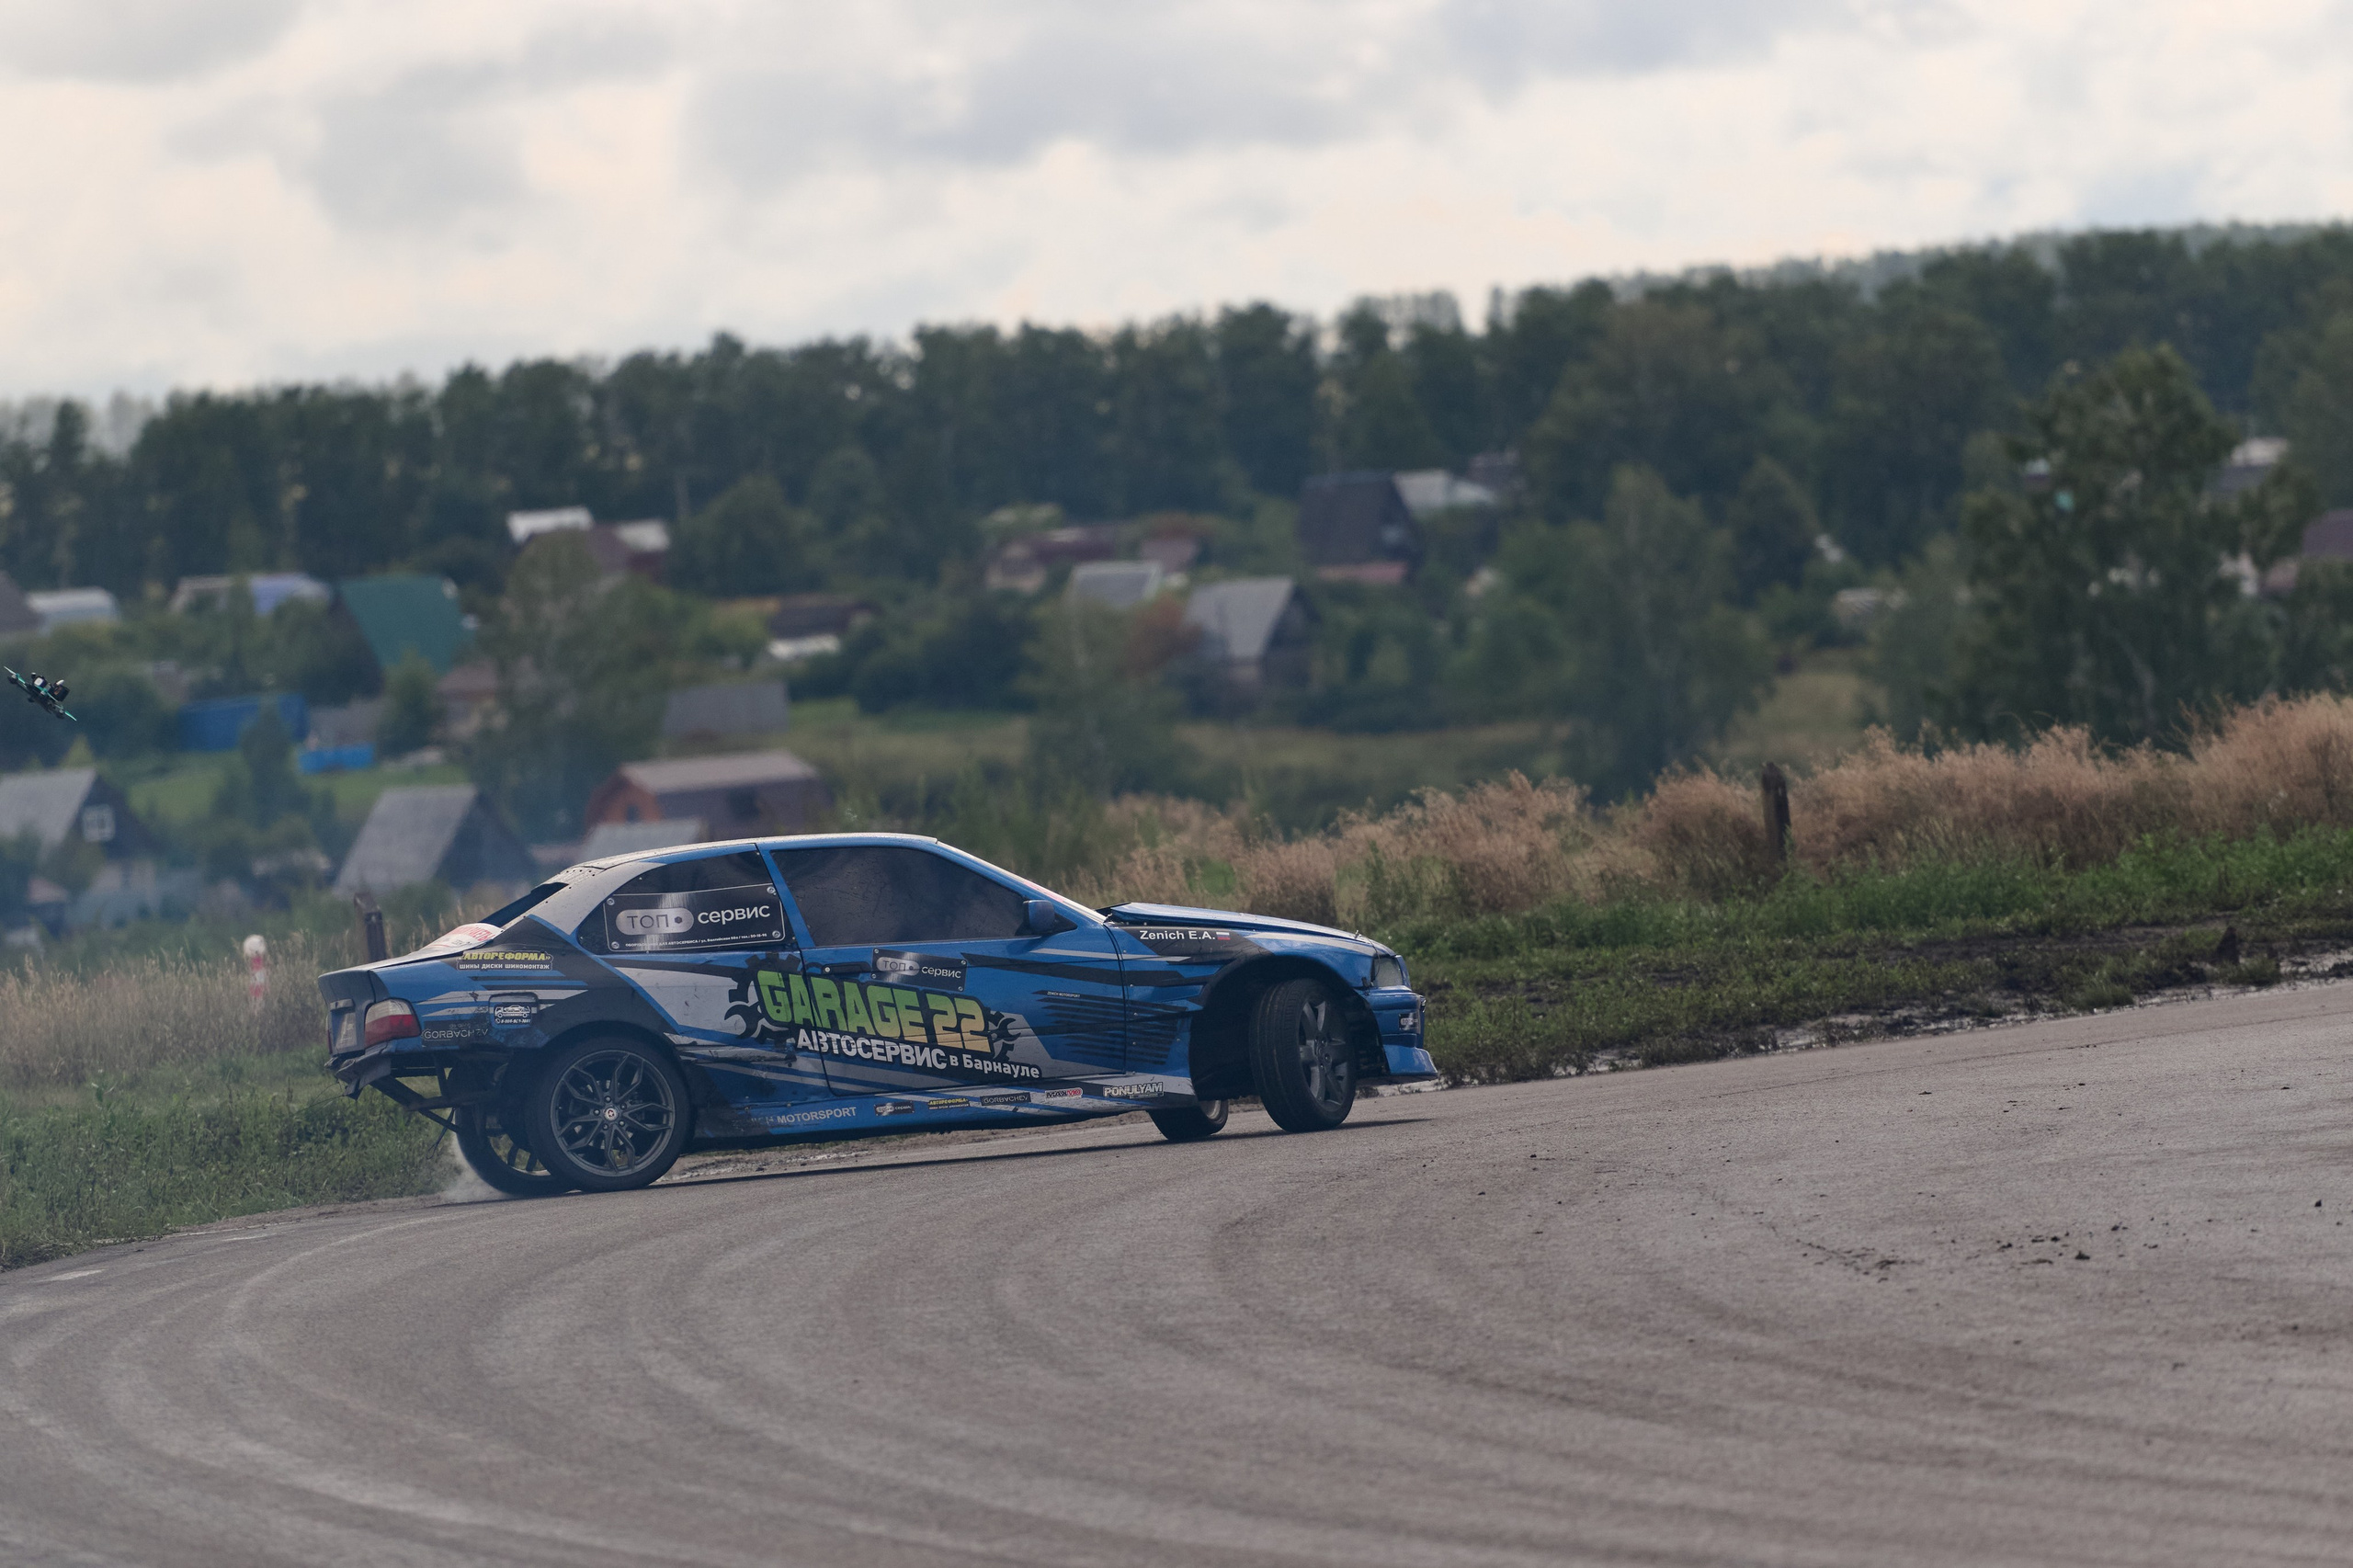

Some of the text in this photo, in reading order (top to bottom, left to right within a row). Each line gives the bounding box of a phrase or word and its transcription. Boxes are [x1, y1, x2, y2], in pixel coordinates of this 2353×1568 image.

[627, 905, 770, 929] ТОП сервис
[1140, 930, 1215, 940] Zenich E.A.
[883, 960, 961, 979] ТОП сервис
[757, 970, 992, 1052] GARAGE 22
[797, 1028, 1040, 1078] АВТОСЕРВИС в Барнауле
[777, 1107, 857, 1124] MOTORSPORT
